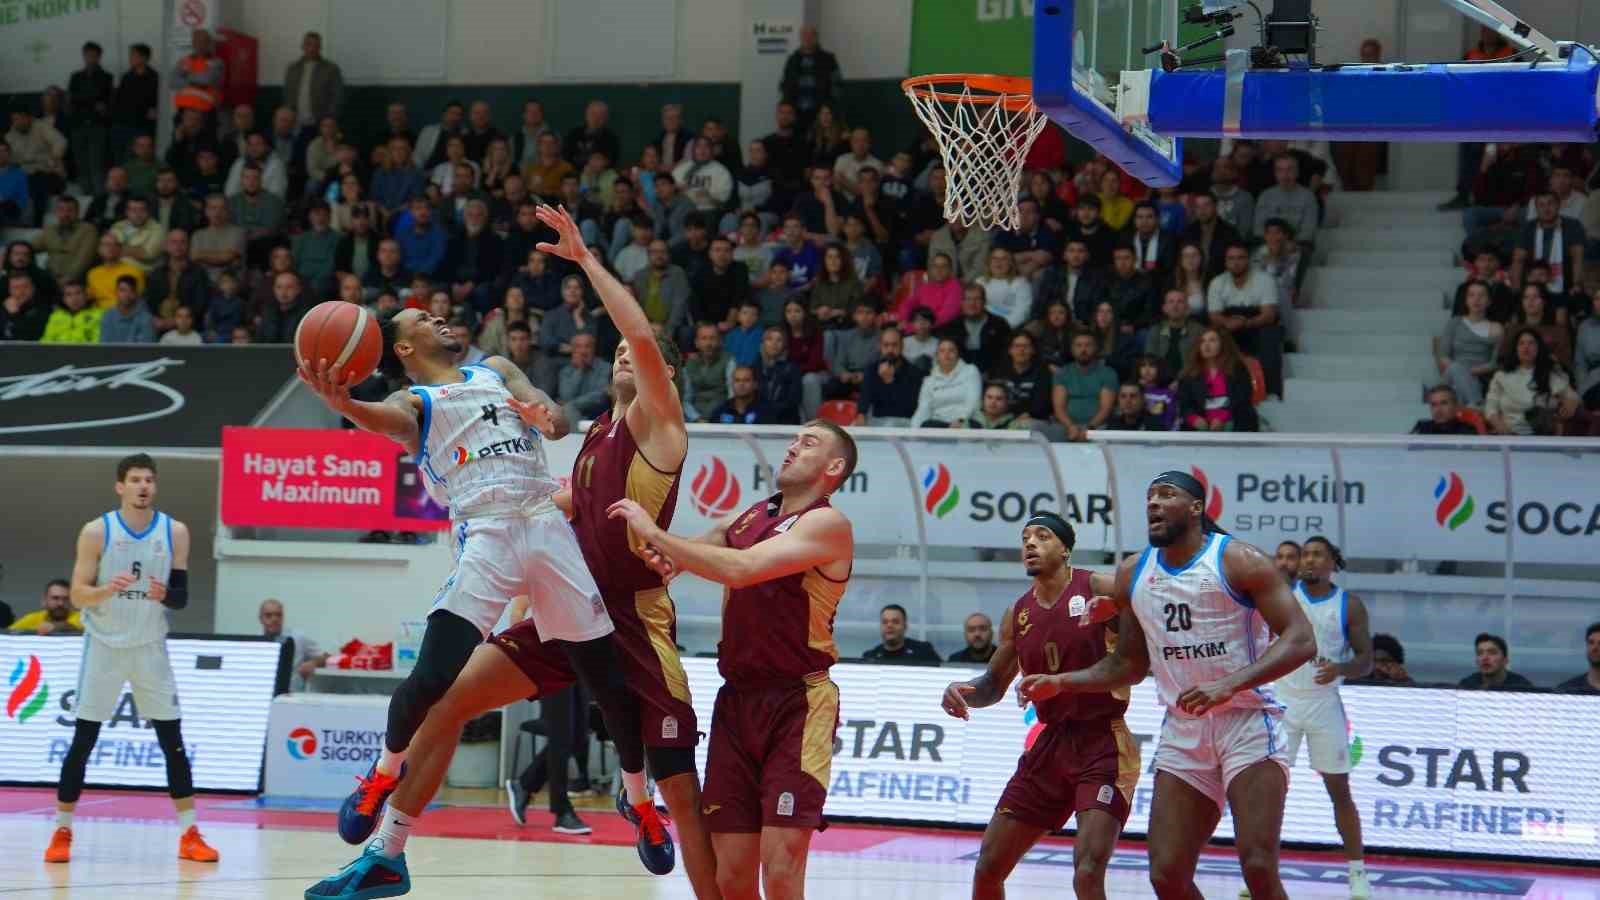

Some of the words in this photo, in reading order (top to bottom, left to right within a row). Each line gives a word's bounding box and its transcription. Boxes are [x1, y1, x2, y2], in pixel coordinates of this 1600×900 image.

[481, 403, 499, 426] 4
[243, 452, 316, 480] Hayat
[322, 454, 382, 476] Sana
[261, 480, 381, 504] Maximum
[1236, 473, 1365, 505] Petkim
[1235, 514, 1323, 532] SPOR
[1164, 603, 1192, 632] 20
[1375, 744, 1530, 793] STAR
